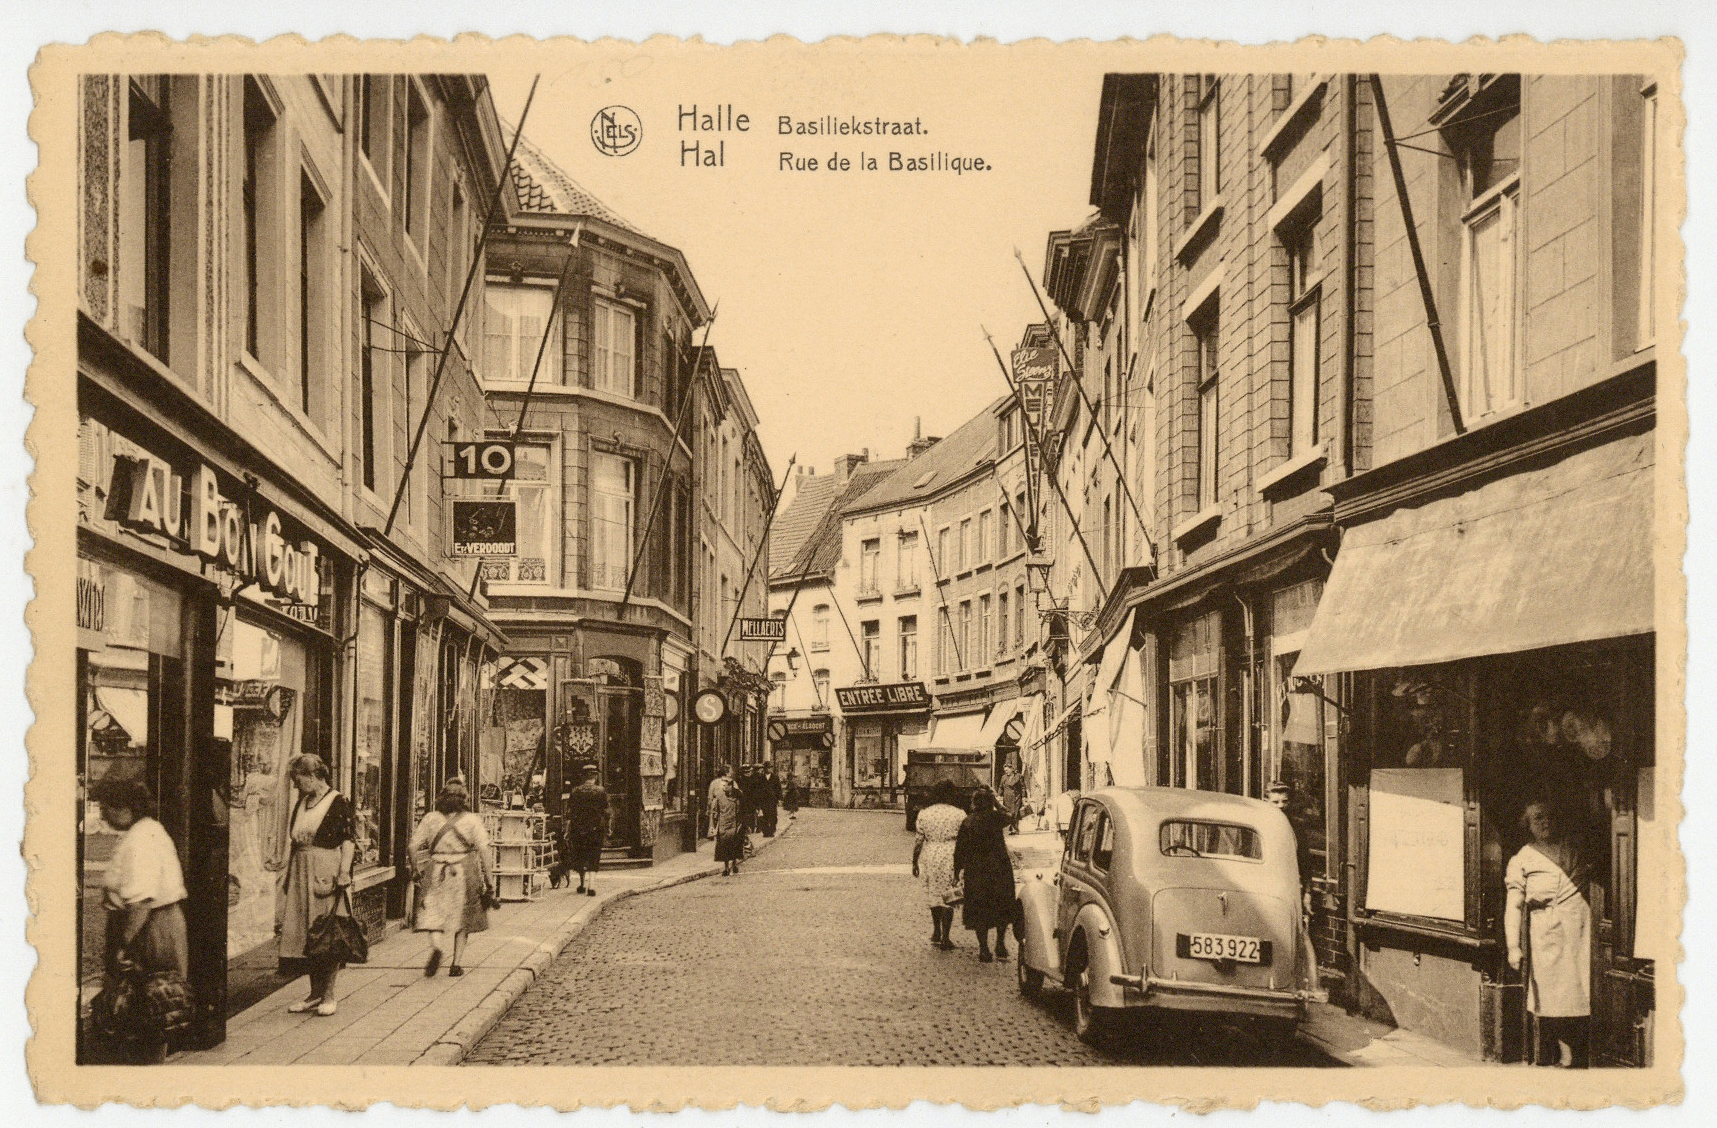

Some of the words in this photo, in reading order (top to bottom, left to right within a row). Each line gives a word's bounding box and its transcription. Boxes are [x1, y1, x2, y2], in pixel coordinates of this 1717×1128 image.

[459, 445, 511, 475] 10
[135, 458, 182, 537] AU
[742, 619, 784, 637] MELLAERTS
[839, 688, 885, 706] ENTRÉE
[887, 685, 923, 703] LIBRE
[702, 696, 717, 718] S
